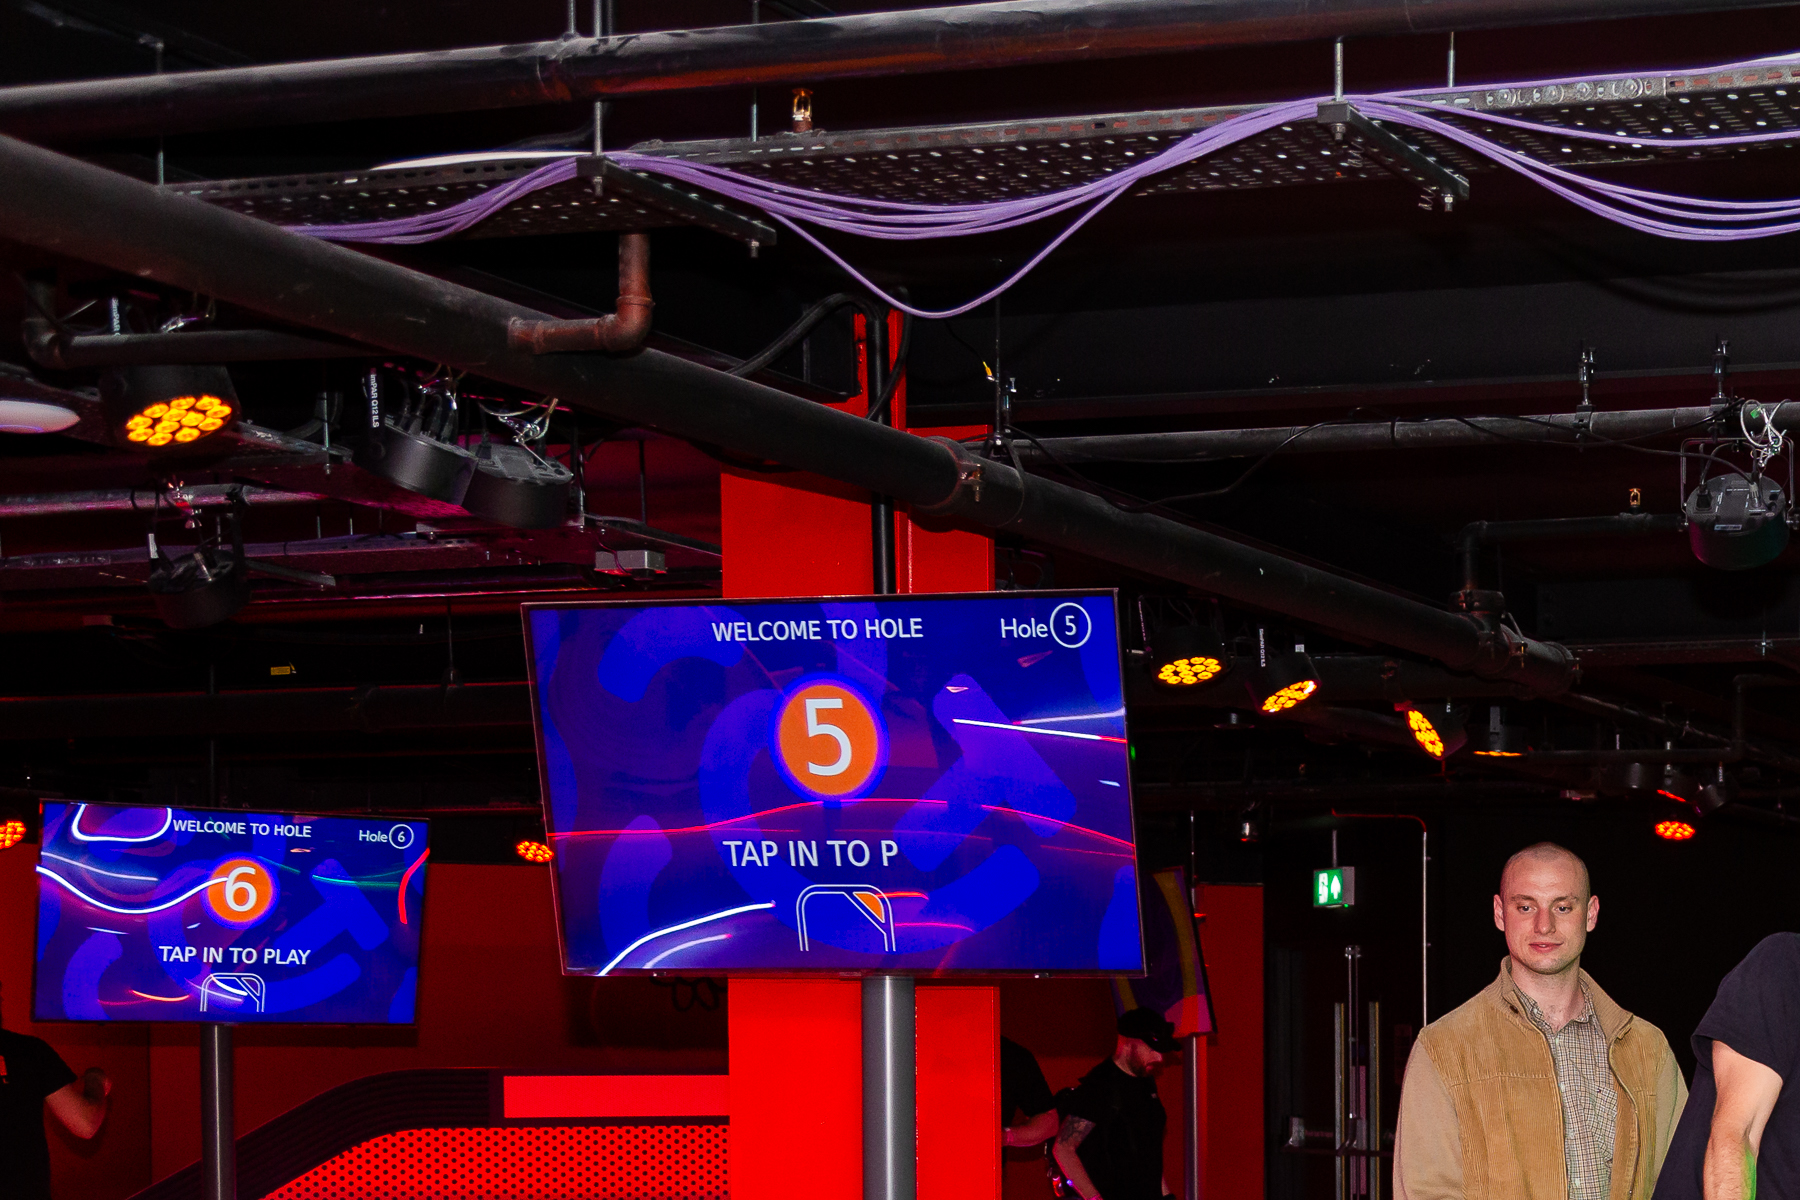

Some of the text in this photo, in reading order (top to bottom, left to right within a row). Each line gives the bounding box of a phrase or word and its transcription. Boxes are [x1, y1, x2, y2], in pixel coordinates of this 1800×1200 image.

[712, 617, 924, 642] WELCOME TO HOLE
[1001, 614, 1077, 640] Hole 5
[804, 698, 853, 777] 5
[173, 819, 312, 838] WELCOME TO HOLE
[359, 829, 406, 843] Hole 6
[723, 840, 899, 867] TAP IN TO P
[225, 866, 258, 913] 6
[158, 945, 311, 966] TAP IN TO PLAY
